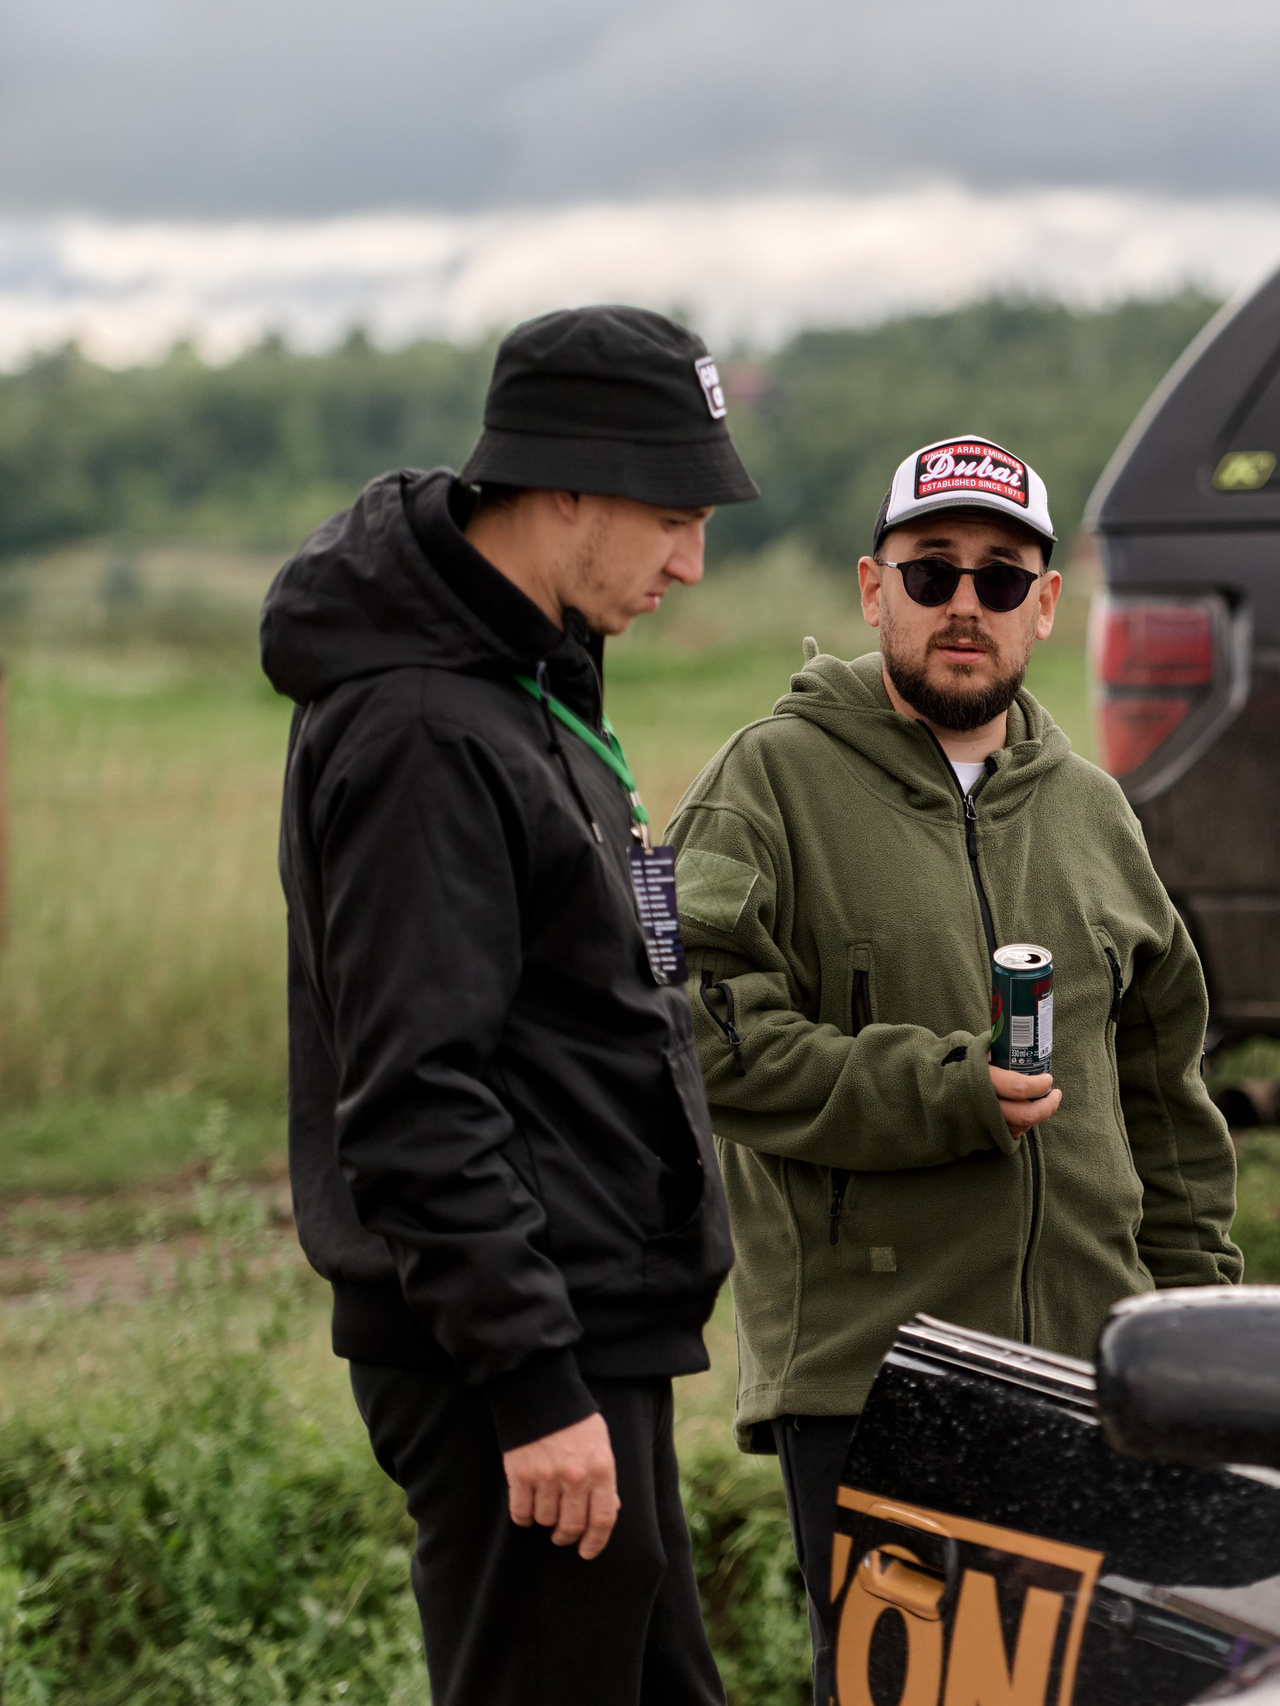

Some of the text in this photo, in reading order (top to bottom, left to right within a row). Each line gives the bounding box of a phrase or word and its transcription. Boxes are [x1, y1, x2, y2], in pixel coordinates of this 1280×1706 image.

[925, 446, 1021, 470] UNITED ARAB EMIRATES
[919, 453, 1021, 488] Dubai
[922, 479, 1021, 499] ESTABLISHED SINCE 1971
